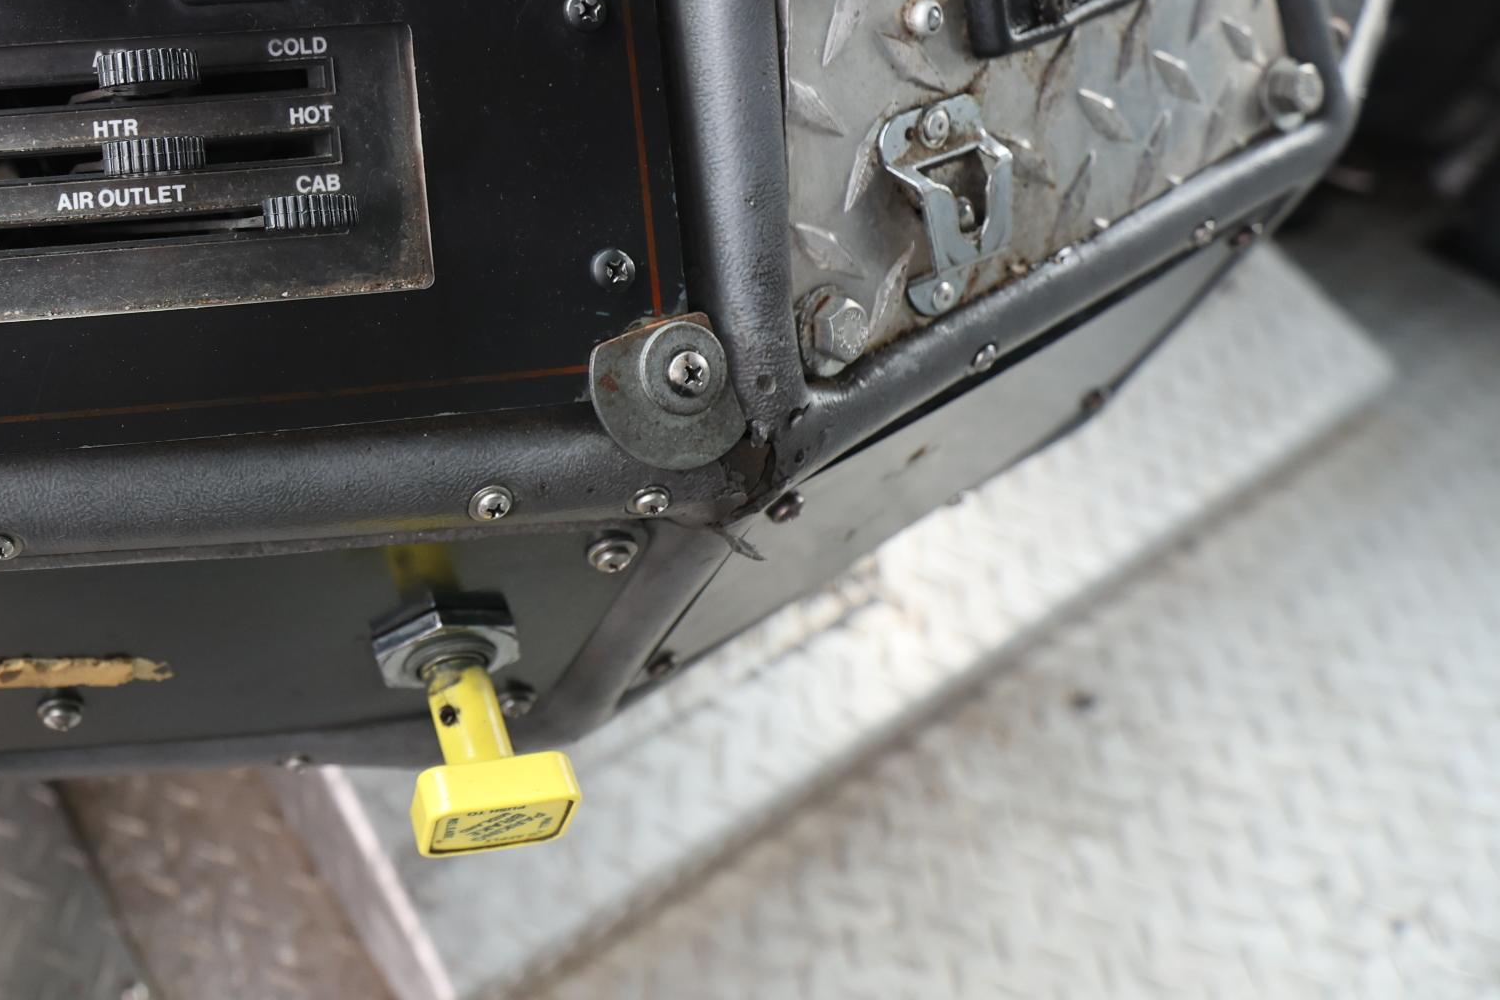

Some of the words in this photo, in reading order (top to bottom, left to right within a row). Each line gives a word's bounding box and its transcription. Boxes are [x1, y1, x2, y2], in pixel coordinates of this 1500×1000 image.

[267, 37, 328, 58] COLD
[289, 105, 334, 126] HOT
[92, 119, 139, 138] HTR
[295, 174, 341, 194] CAB
[57, 192, 94, 212] AIR
[97, 184, 187, 208] OUTLET
